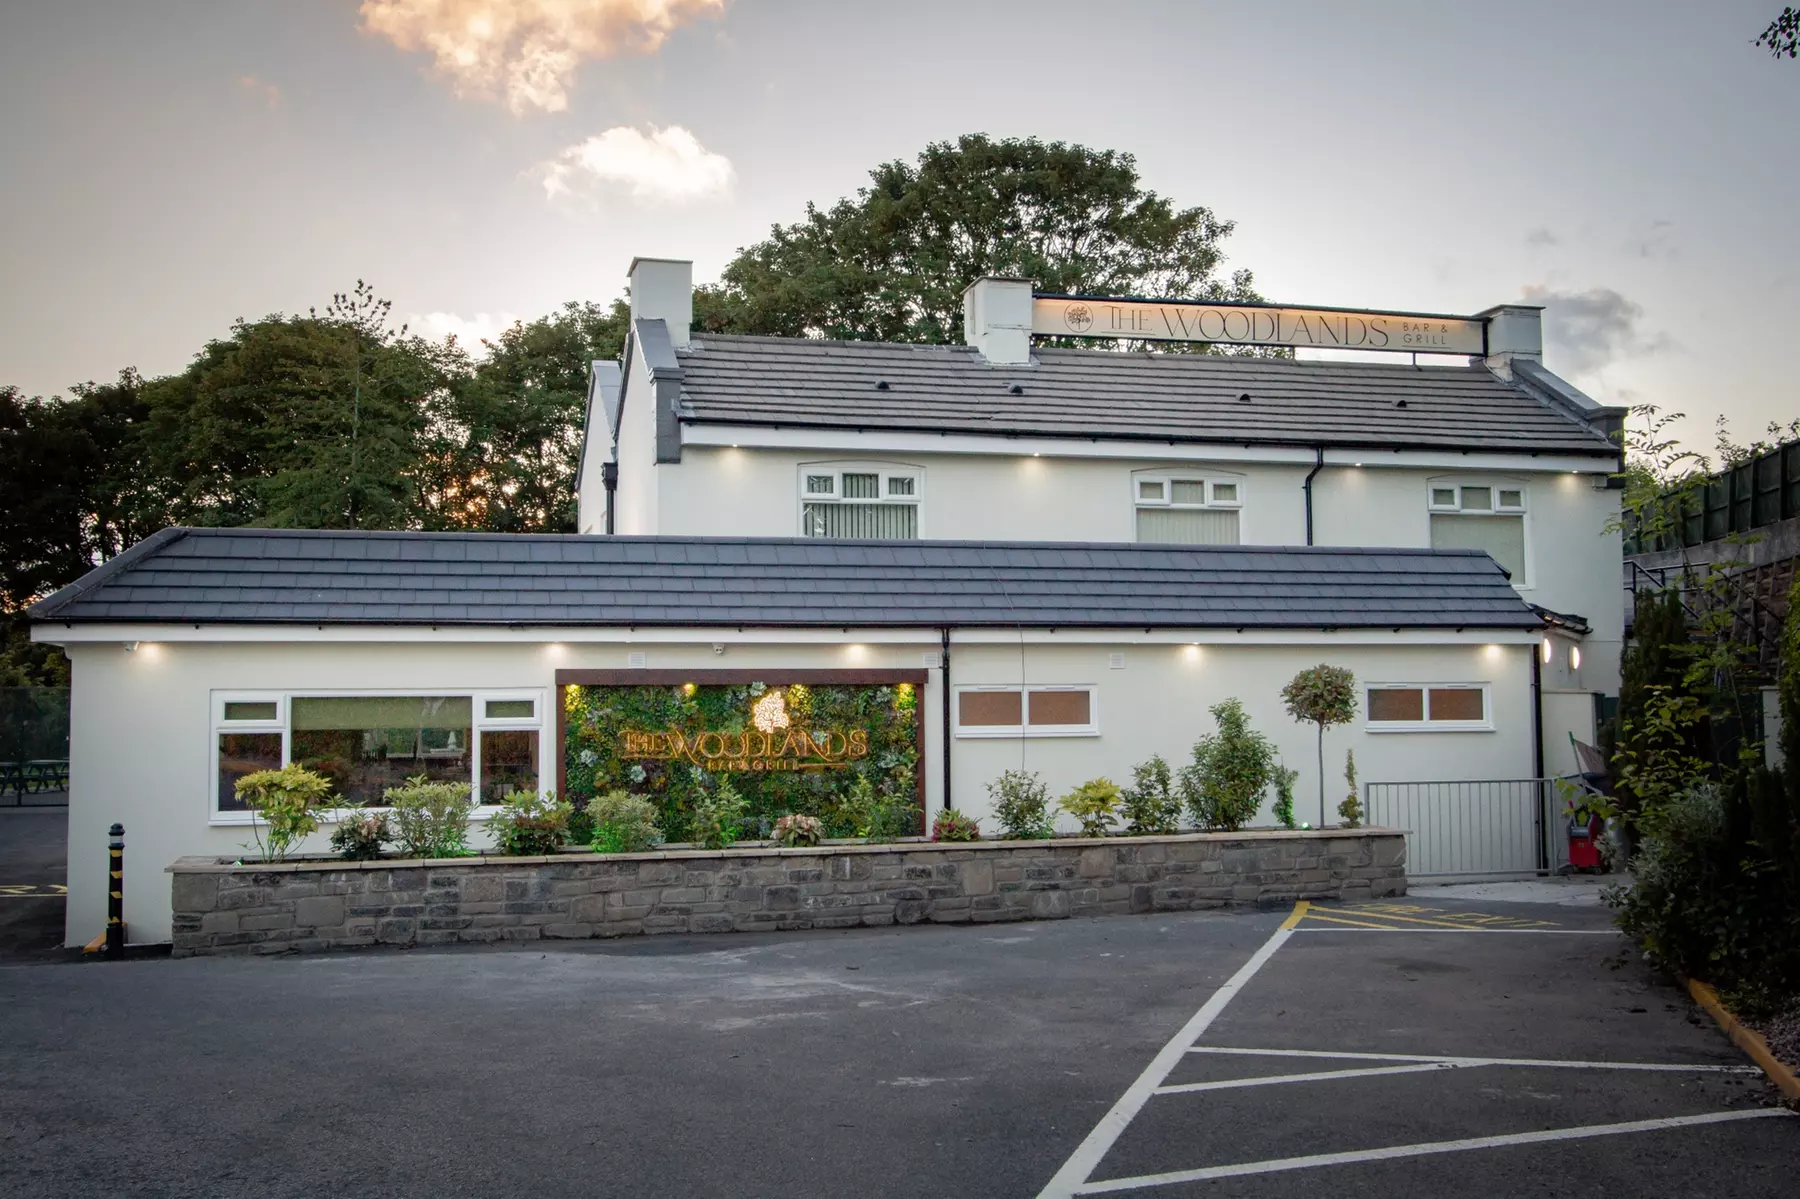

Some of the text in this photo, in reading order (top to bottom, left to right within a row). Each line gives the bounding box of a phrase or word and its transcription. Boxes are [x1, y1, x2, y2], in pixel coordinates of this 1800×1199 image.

[1100, 305, 1391, 348] THE WOODLANDS
[1402, 321, 1449, 334] BAR &
[1402, 333, 1448, 346] GRILL
[665, 729, 869, 764] WOODLANDS
